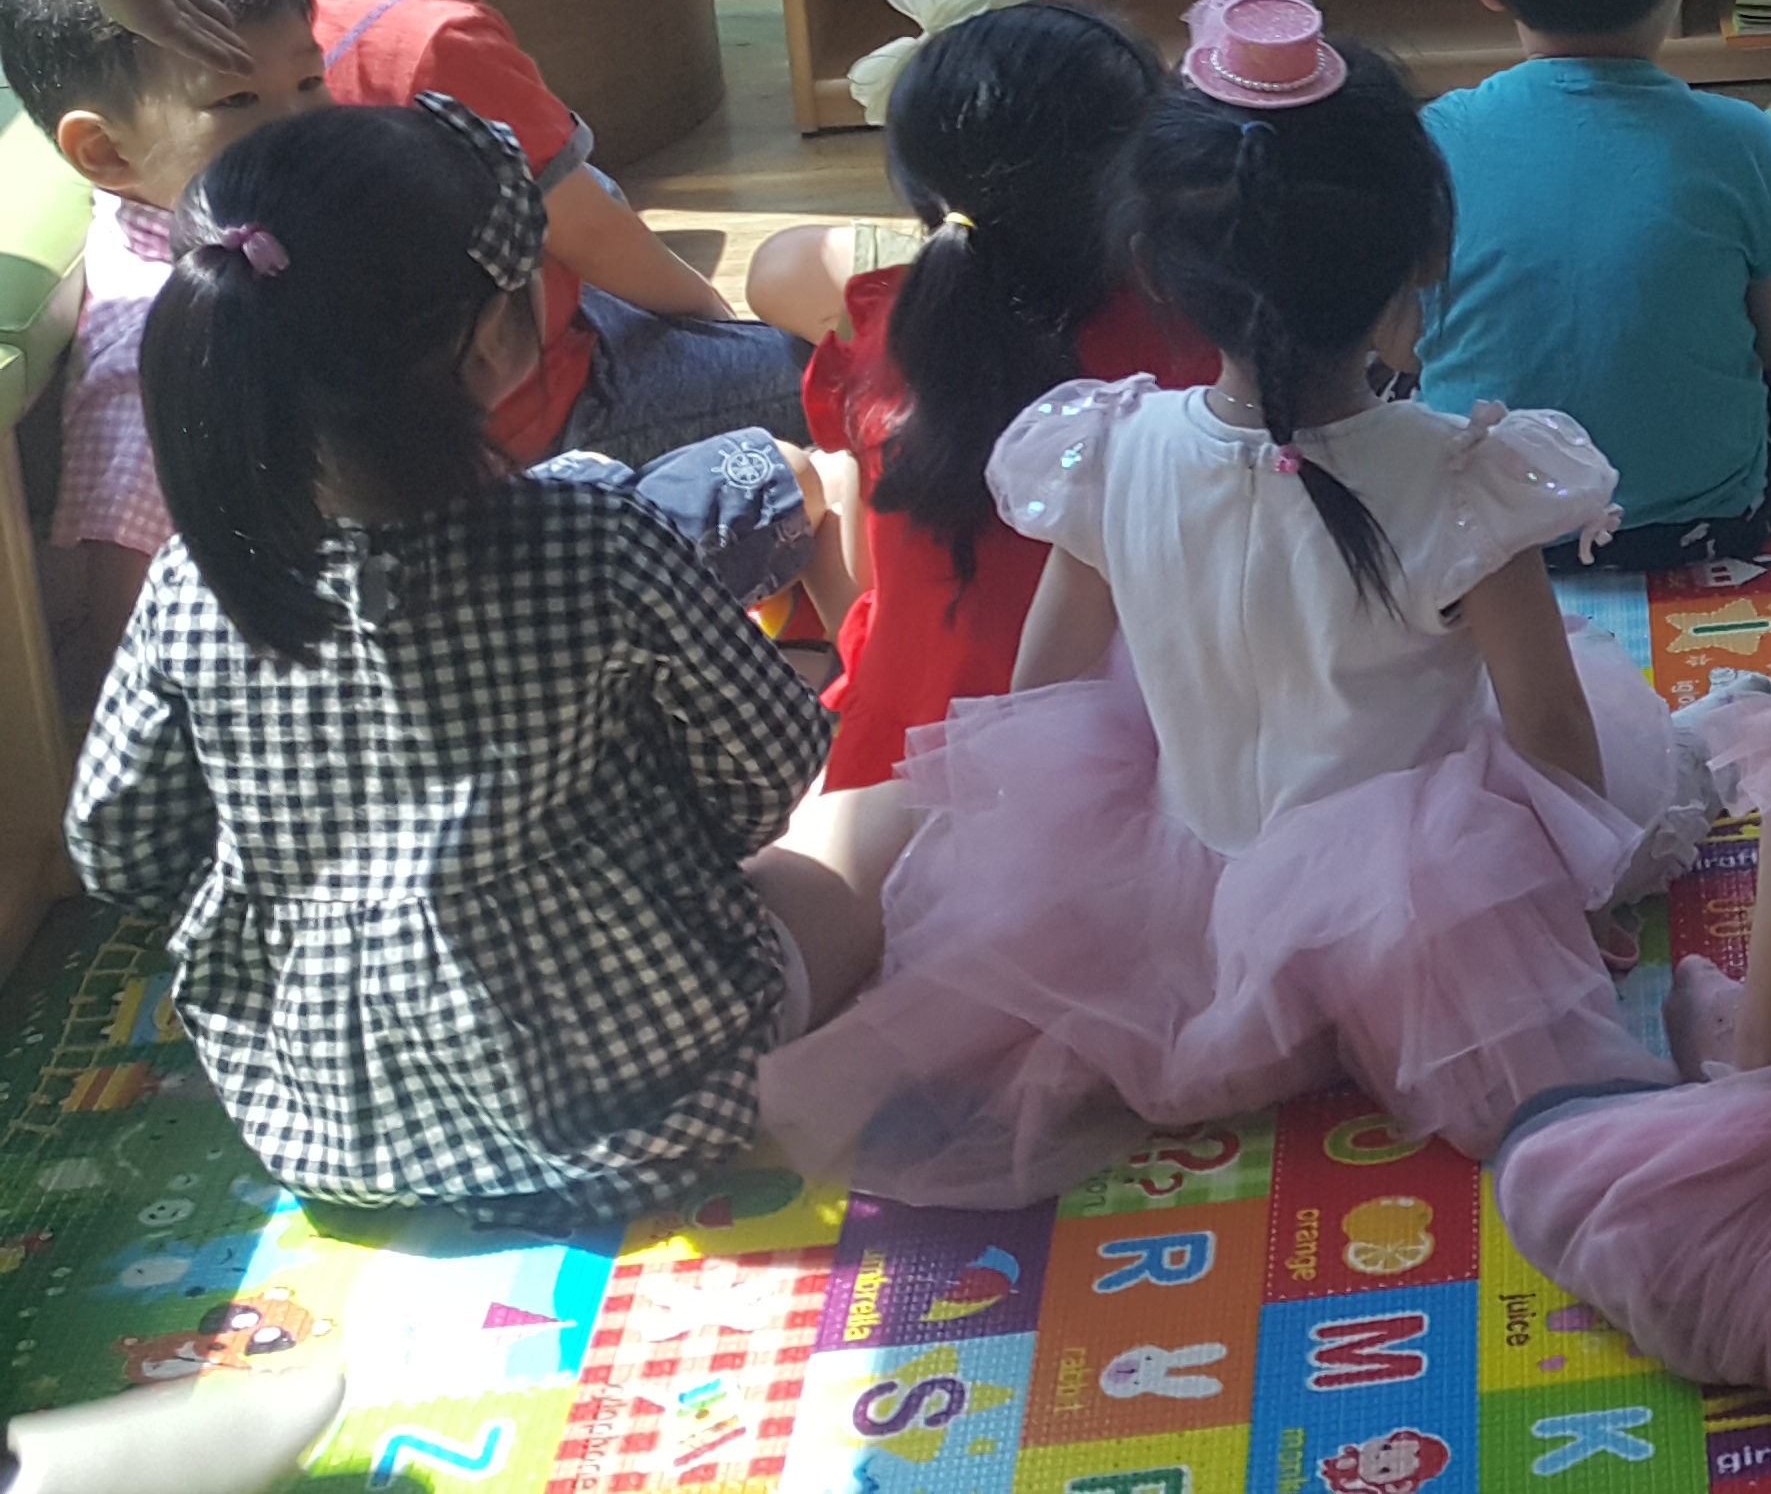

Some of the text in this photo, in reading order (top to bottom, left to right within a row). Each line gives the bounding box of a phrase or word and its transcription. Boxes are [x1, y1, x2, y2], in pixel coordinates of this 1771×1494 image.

[1092, 1231, 1217, 1295] R
[1284, 1209, 1320, 1281] orange
[1307, 1310, 1430, 1392] M
[1498, 1292, 1537, 1347] juice
[851, 1374, 969, 1438] S
[1278, 1426, 1310, 1494] monk
[1531, 1405, 1655, 1476] K
